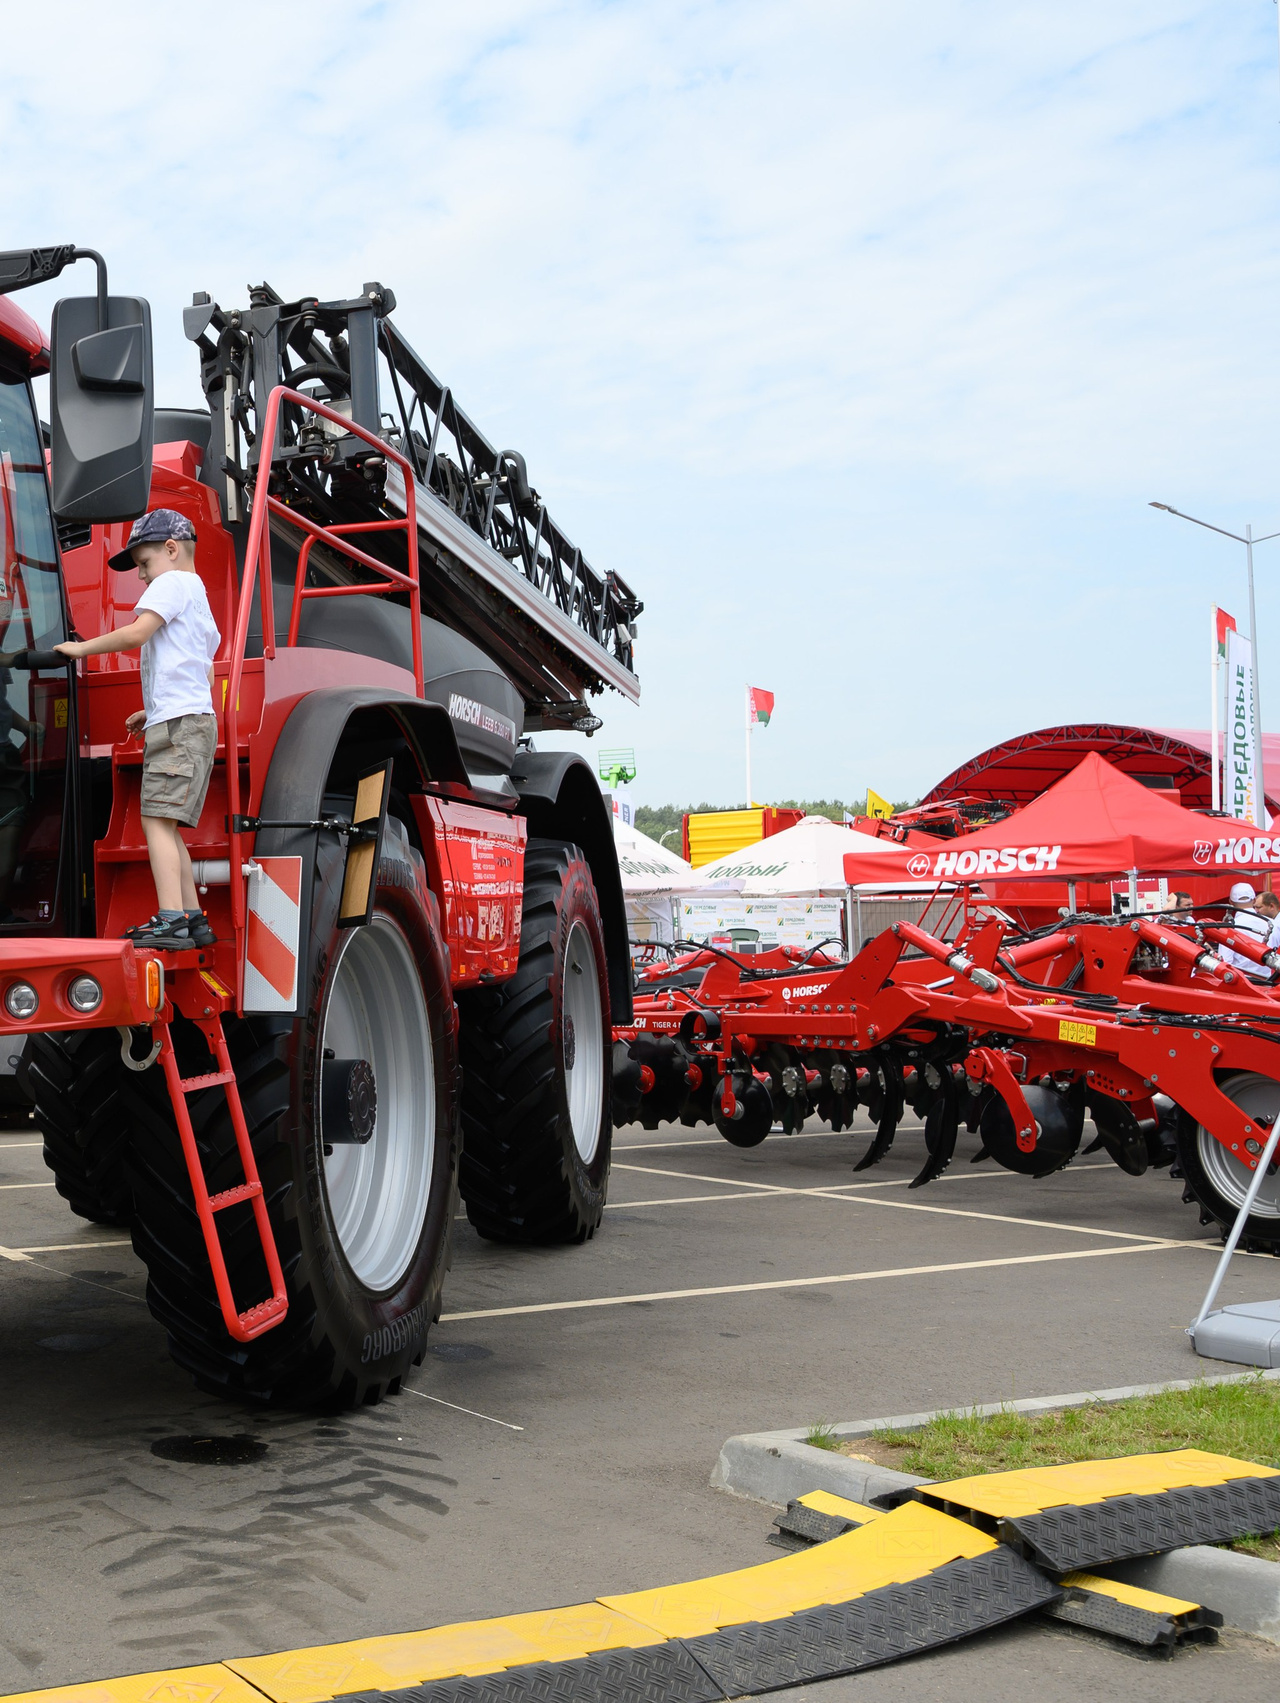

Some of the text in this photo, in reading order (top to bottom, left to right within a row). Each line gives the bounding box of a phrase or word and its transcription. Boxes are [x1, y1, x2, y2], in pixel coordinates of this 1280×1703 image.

[449, 693, 482, 726] HORSCH
[933, 845, 1062, 877] HORSCH
[793, 983, 831, 998] HORSC
[652, 1021, 672, 1029] TIGER
